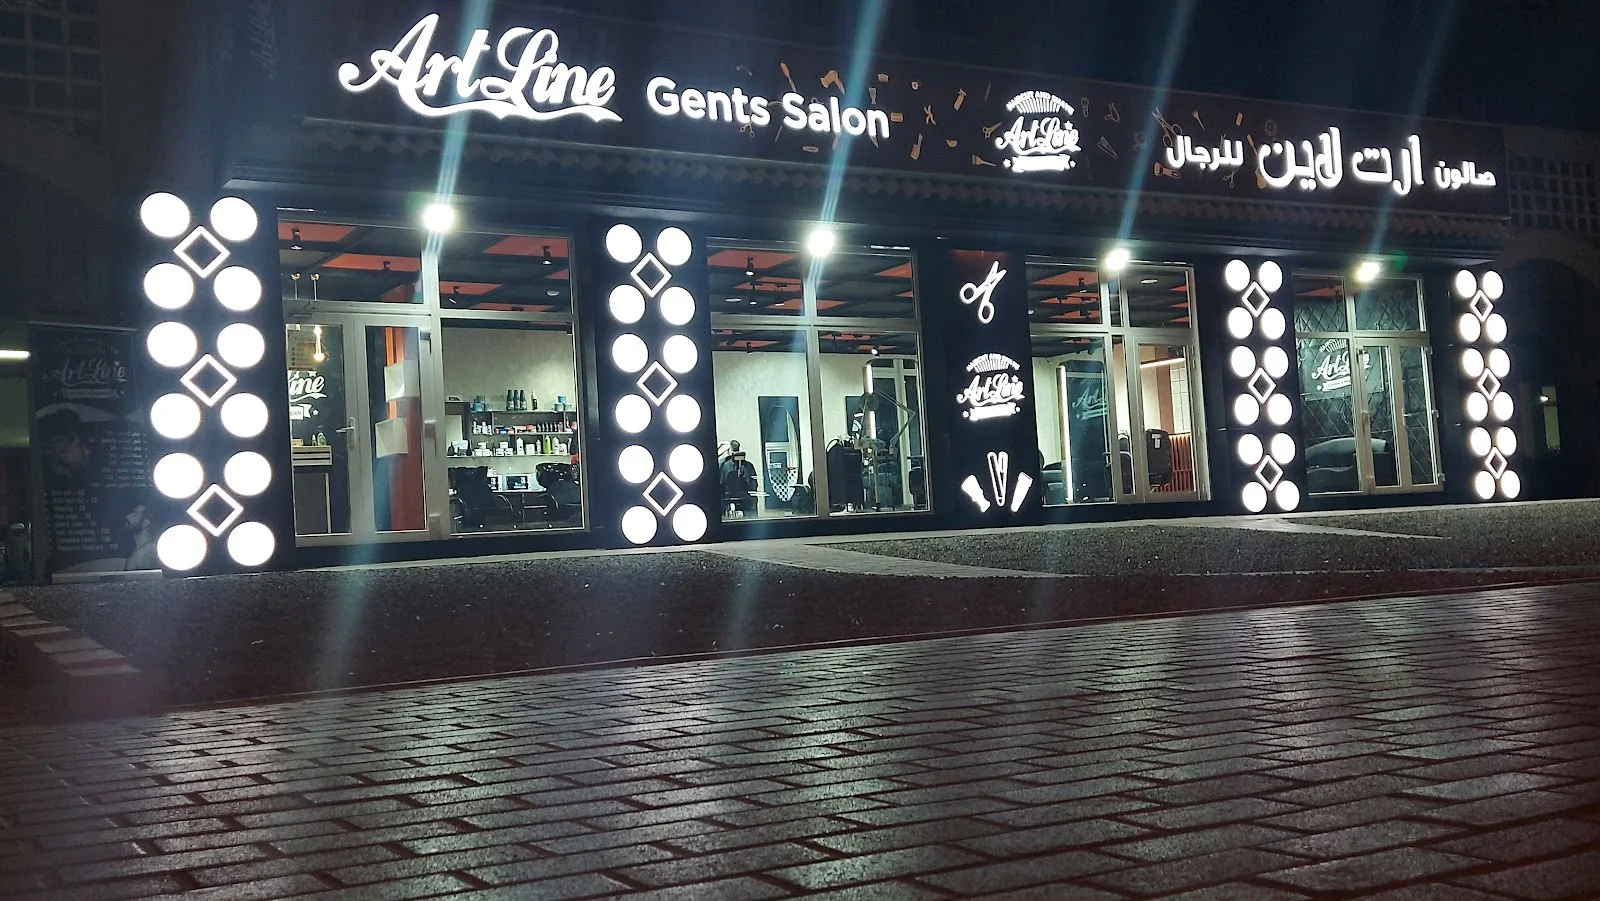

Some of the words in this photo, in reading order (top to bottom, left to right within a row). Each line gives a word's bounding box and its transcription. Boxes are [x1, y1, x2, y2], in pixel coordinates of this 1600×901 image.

[338, 13, 491, 116] Art
[480, 26, 623, 122] Line
[646, 76, 772, 131] Gents
[782, 92, 891, 139] Salon
[995, 115, 1039, 156] Art
[1166, 135, 1244, 170] للرجال
[1434, 160, 1496, 190] صالون
[956, 374, 992, 407] Art
